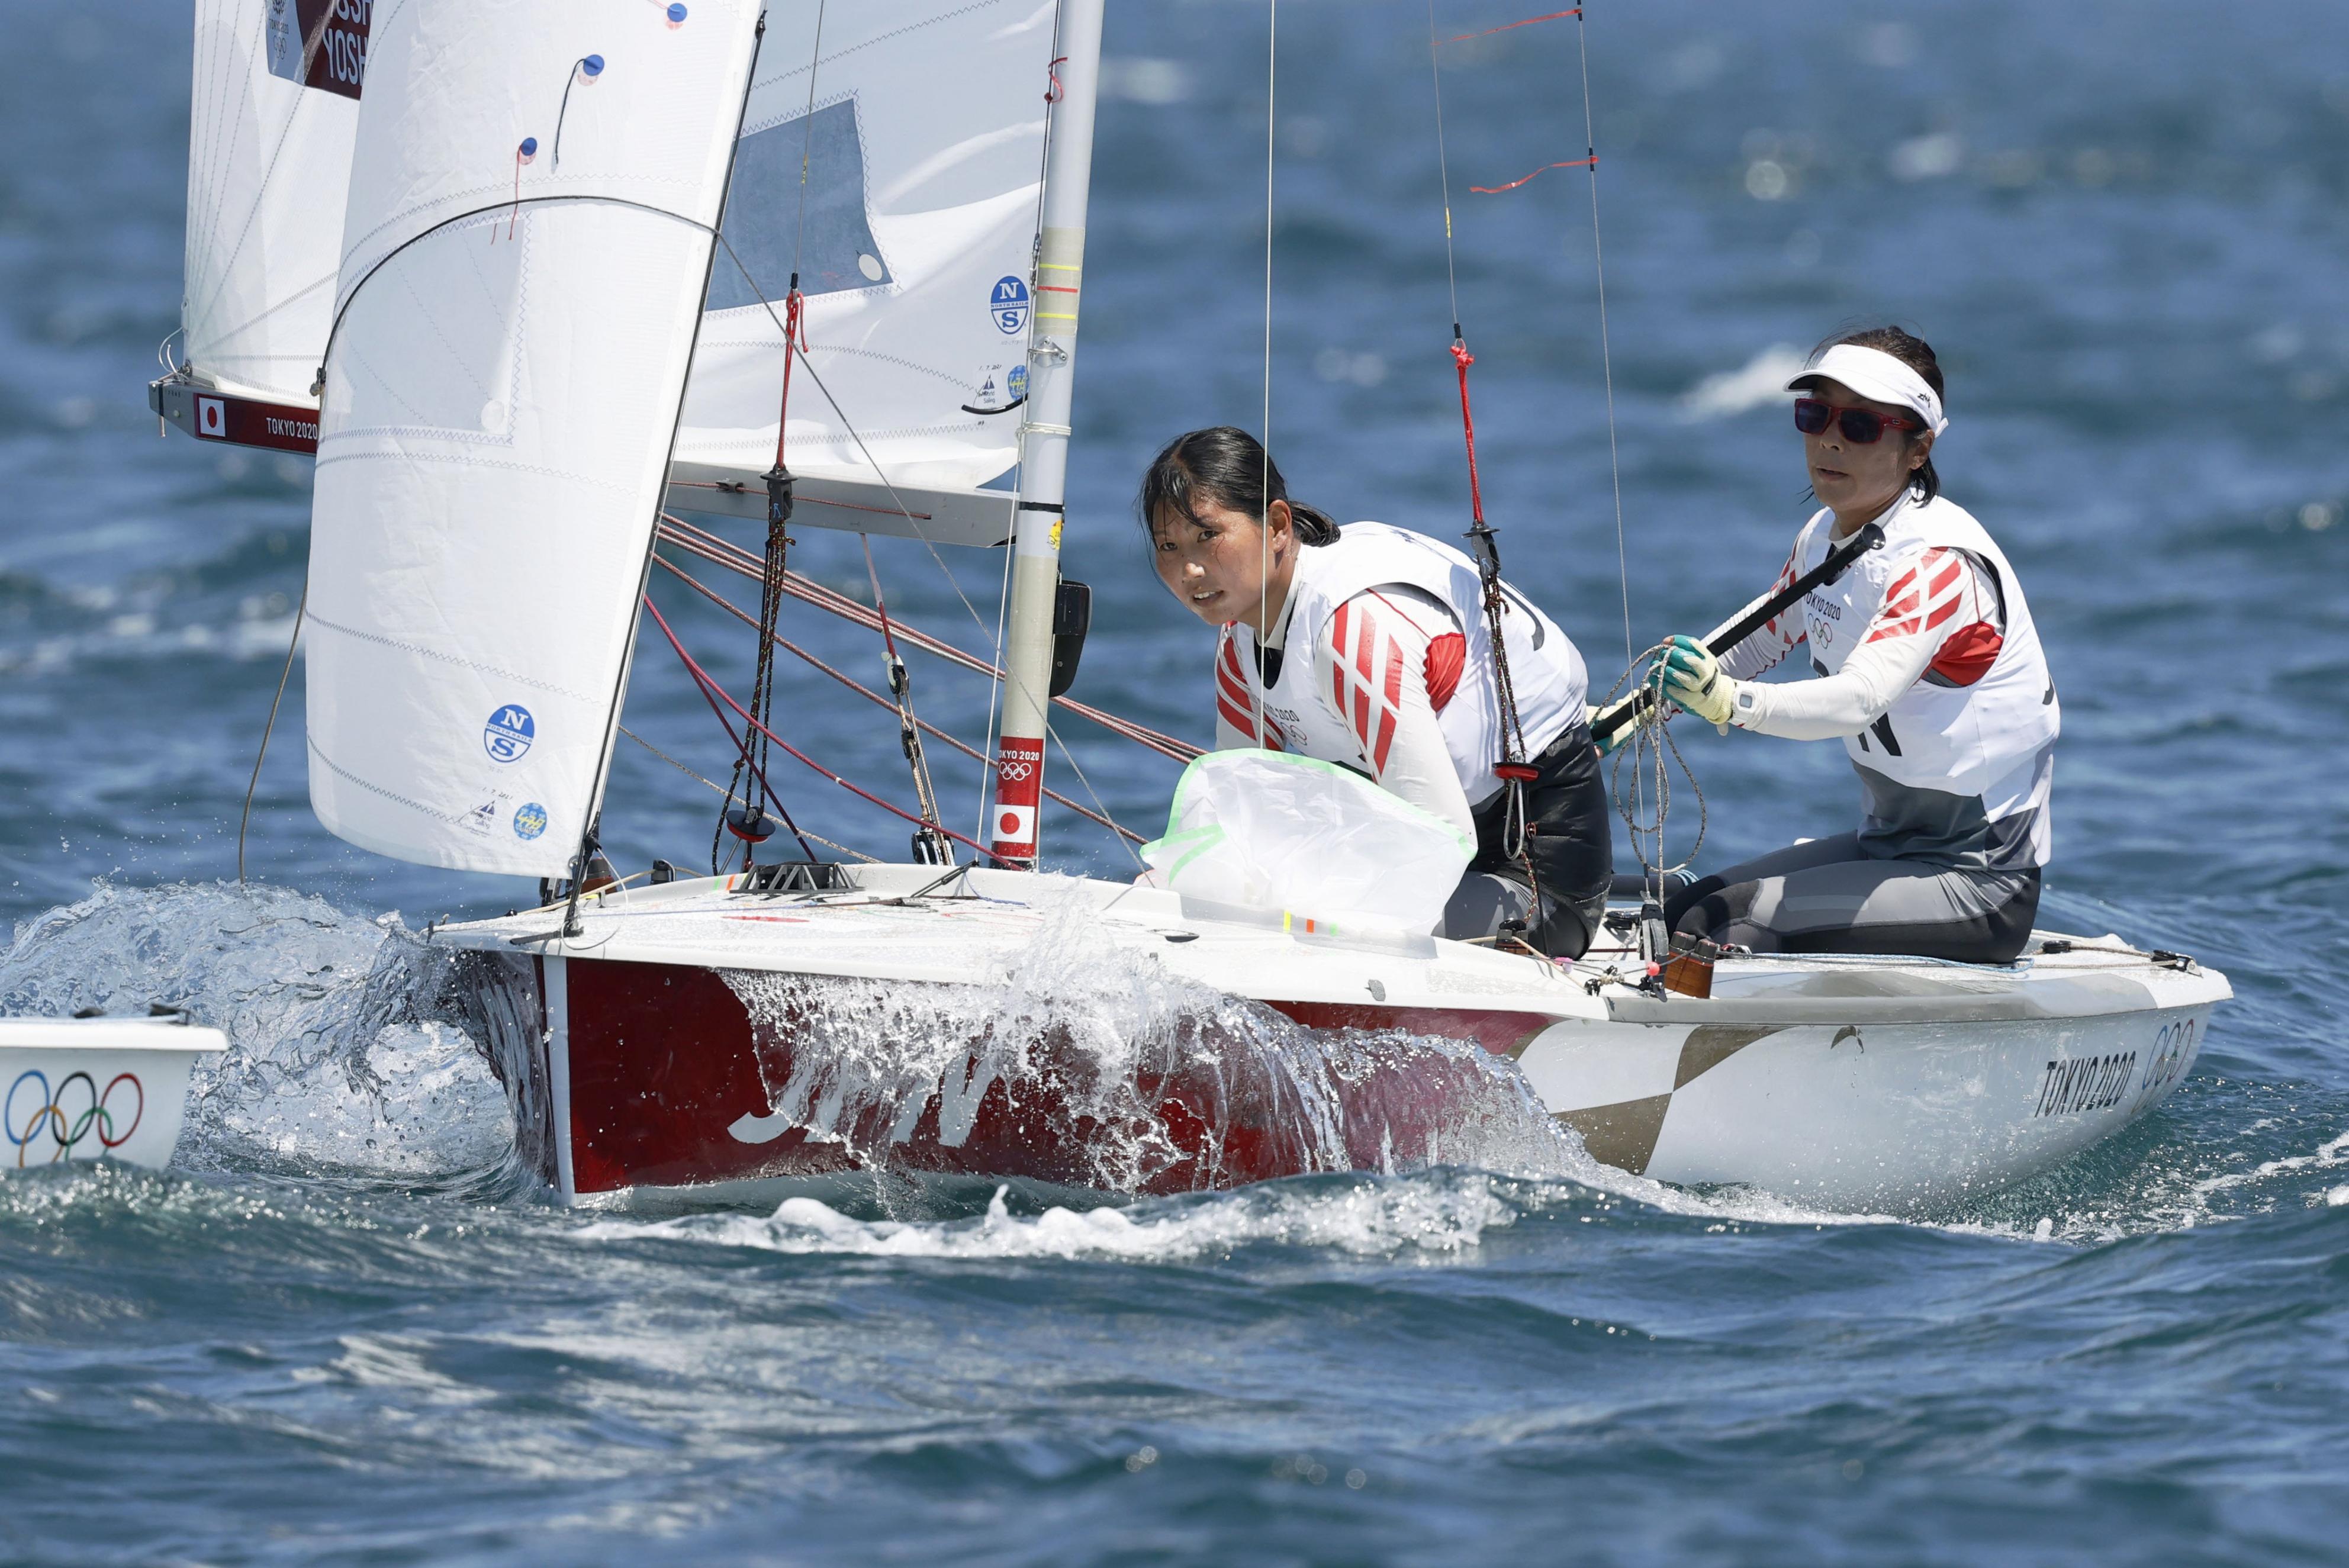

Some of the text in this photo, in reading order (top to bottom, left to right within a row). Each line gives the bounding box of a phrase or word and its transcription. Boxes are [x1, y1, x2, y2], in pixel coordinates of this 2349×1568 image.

[999, 282, 1019, 300] N
[1001, 311, 1019, 328] S
[266, 417, 318, 440] TOKYO 2020
[1806, 591, 1841, 621] OKYO 2020
[500, 708, 529, 731] N
[1275, 707, 1300, 722] 2020
[491, 737, 516, 757] S
[998, 749, 1040, 761] OKYO 2020
[2034, 1050, 2136, 1118] TOKYO 2020
